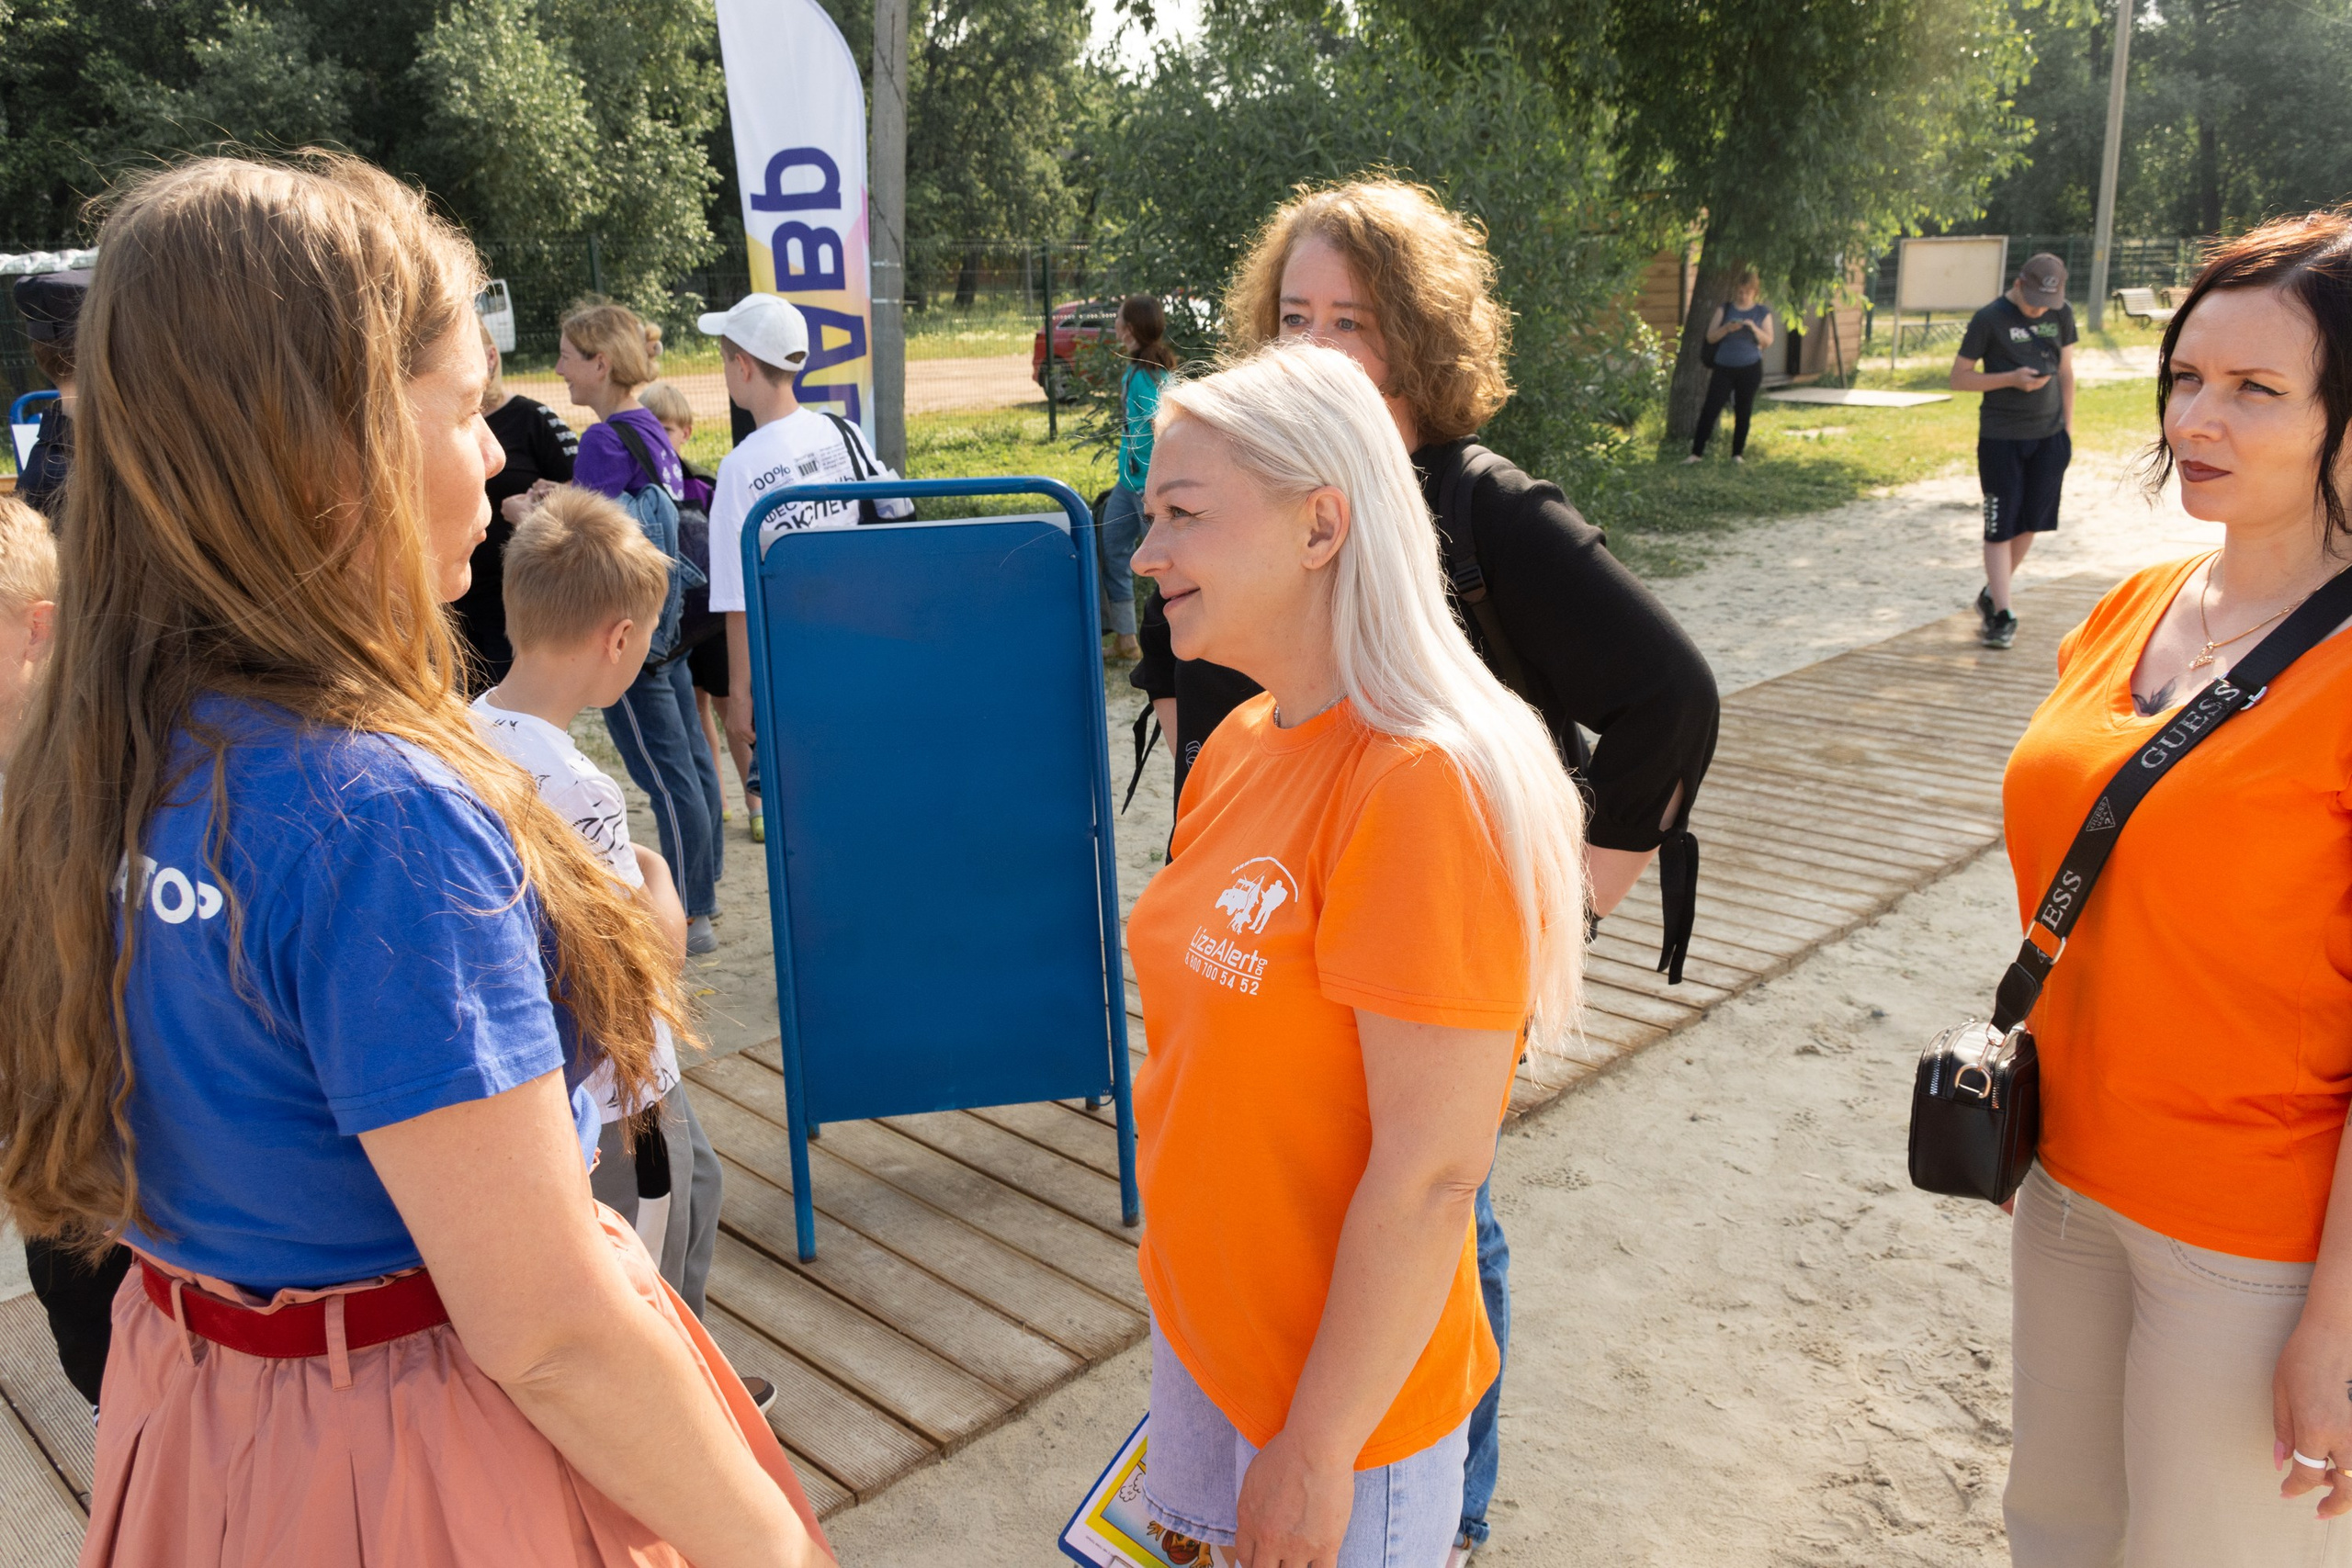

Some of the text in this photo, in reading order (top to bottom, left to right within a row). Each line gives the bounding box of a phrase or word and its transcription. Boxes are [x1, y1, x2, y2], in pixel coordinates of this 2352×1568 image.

[2140, 682, 2242, 770] GUESS
[1190, 925, 1259, 973] LizaAlert
[1255, 958, 1268, 976] org
[1202, 962, 1218, 981] 700
[1219, 970, 1236, 989] 54
[1239, 977, 1260, 996] 52
